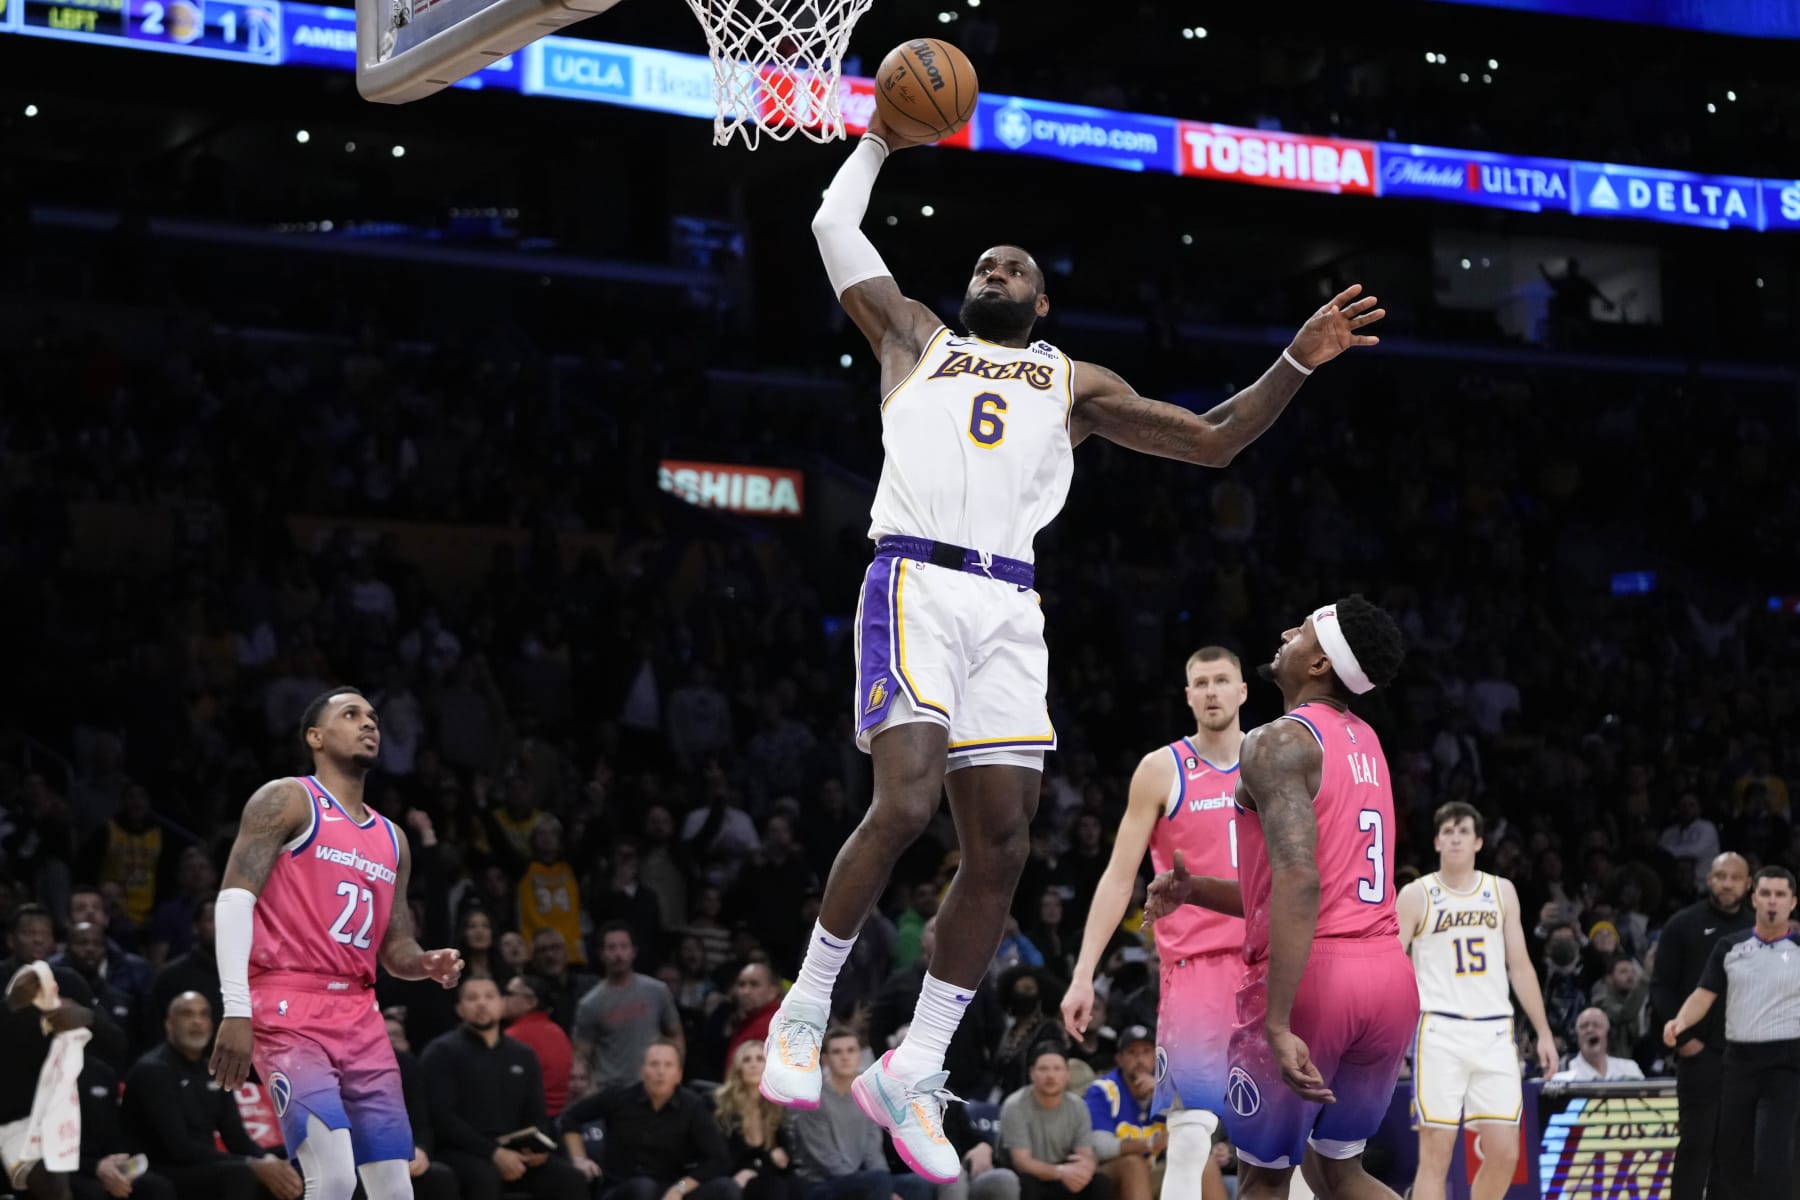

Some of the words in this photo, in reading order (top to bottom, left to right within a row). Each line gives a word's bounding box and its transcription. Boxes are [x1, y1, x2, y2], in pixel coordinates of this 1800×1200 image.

[140, 1, 165, 34] 2
[218, 10, 237, 43] 1
[551, 53, 624, 88] UCLA
[1033, 117, 1157, 154] crypto.com
[1184, 130, 1370, 187] TOSHIBA
[1481, 164, 1567, 200] ULTRA
[1628, 179, 1748, 218] DELTA
[927, 350, 1054, 391] LAKERS
[967, 391, 1008, 451] 6
[315, 845, 397, 885] washington
[1358, 808, 1387, 905] 3
[328, 880, 374, 950] 22
[1431, 908, 1498, 935] LAKERS
[1452, 937, 1488, 977] 15
